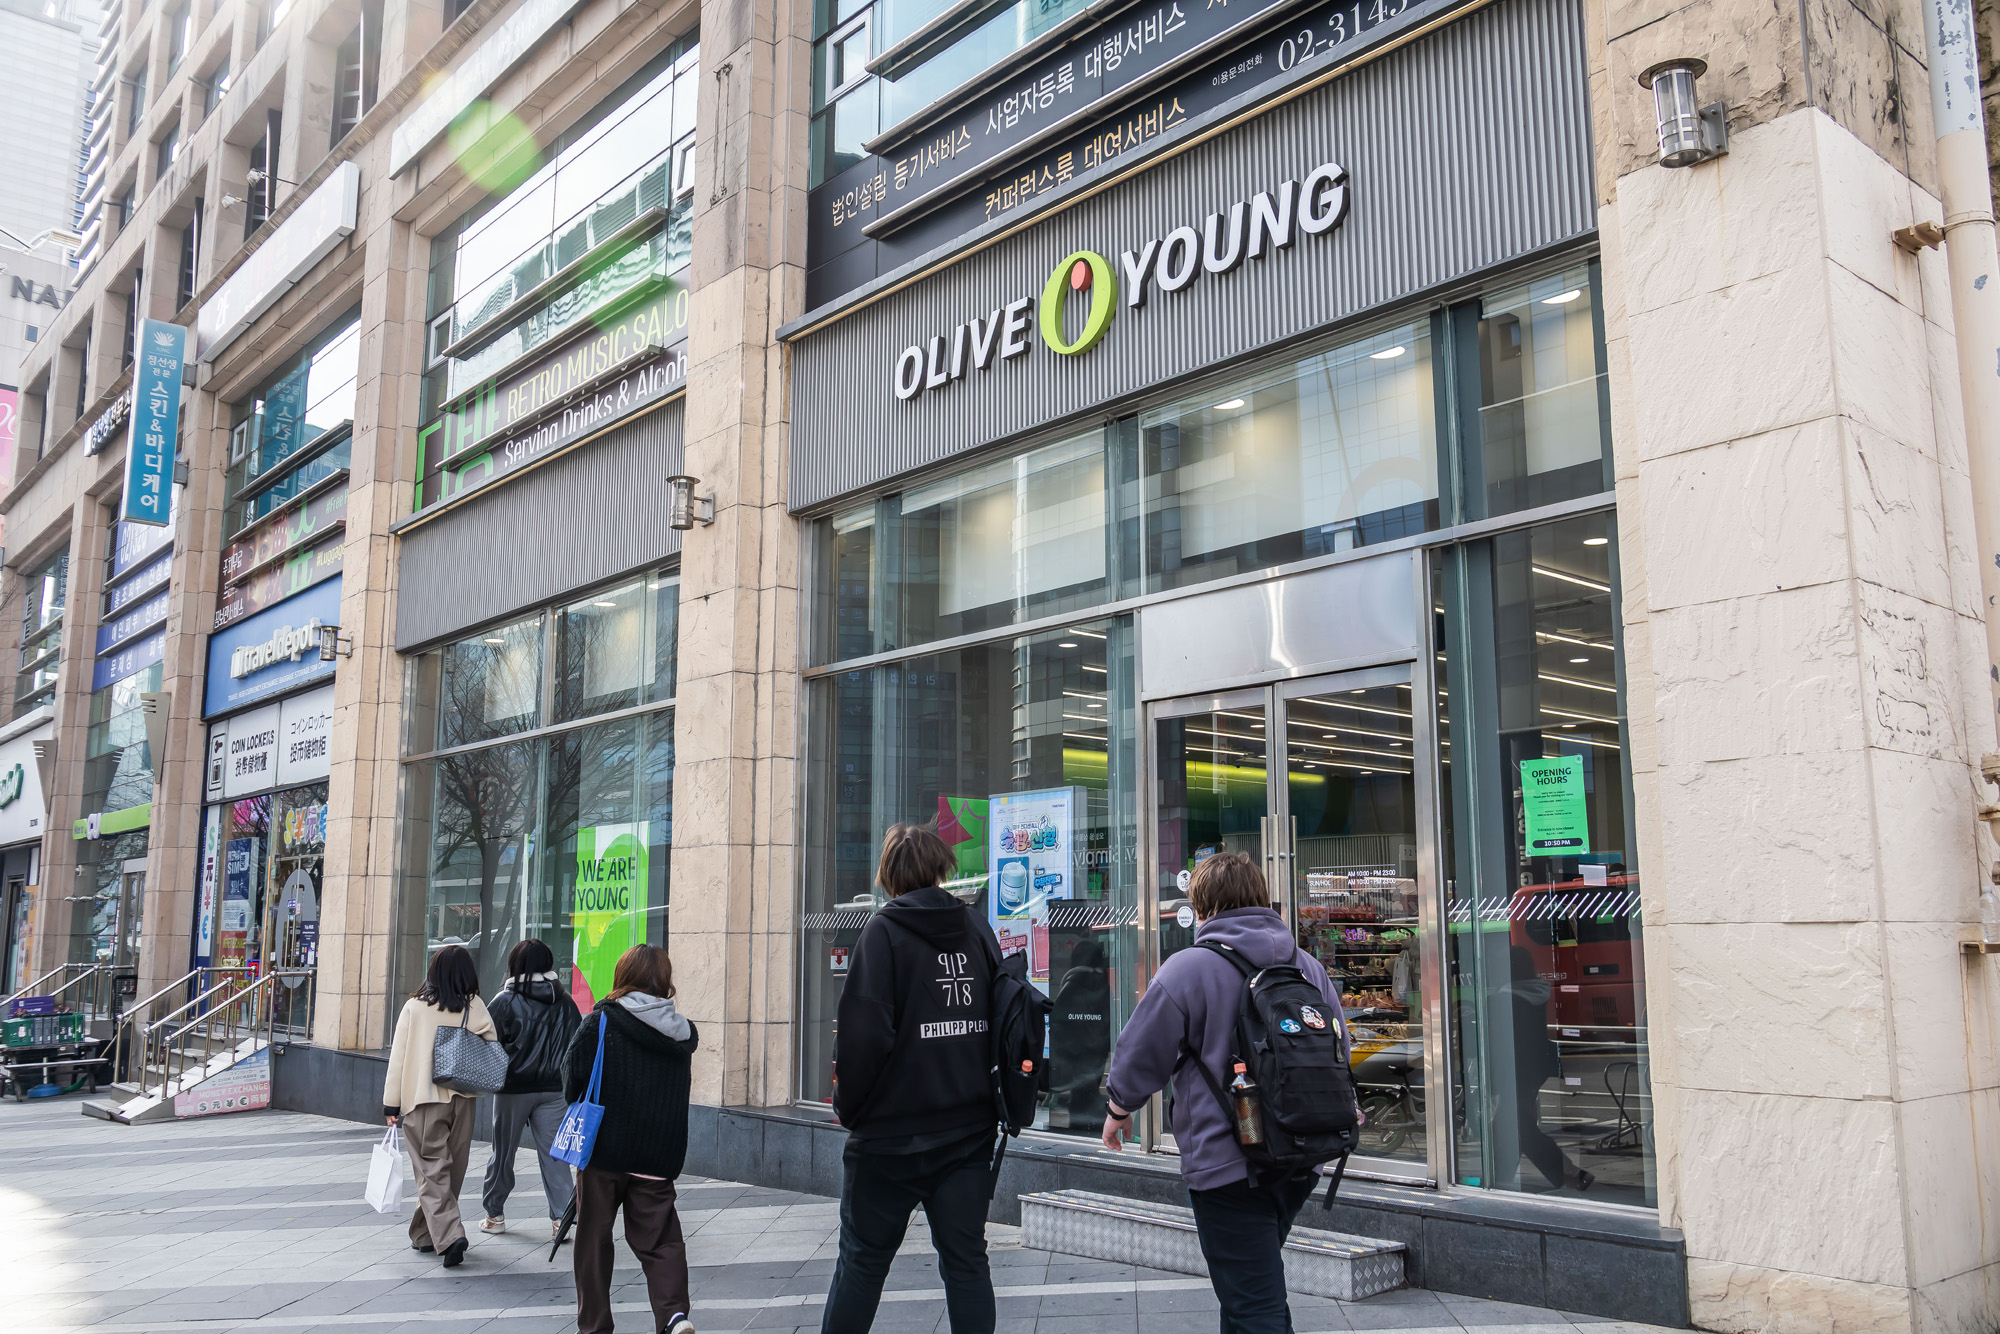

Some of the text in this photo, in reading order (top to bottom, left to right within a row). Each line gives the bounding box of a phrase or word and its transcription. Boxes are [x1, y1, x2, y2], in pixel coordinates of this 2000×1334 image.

[832, 1, 1187, 227] 법인설립 등기서비스 사업자등록 대행서비스
[985, 151, 1075, 222] 컨퍼런스룸
[1084, 97, 1187, 169] 대여서비스
[1212, 53, 1263, 86] 이용문의전화
[895, 296, 1035, 400] OLIVE
[1121, 162, 1349, 309] YOUNG
[147, 354, 177, 370] 정선생
[507, 363, 562, 423] RETRO
[566, 324, 627, 390] MUSIC
[562, 394, 613, 438] Drinks
[617, 379, 631, 410] &
[140, 380, 169, 514] 스킨&바디케어
[110, 634, 165, 678] 문제성 피부
[243, 617, 321, 676] traveldepot
[291, 710, 333, 735] コインロッカー
[231, 730, 275, 754] COIN LOCKERS
[1531, 767, 1572, 778] OPENING
[1536, 776, 1568, 786] HOURS
[227, 861, 240, 875] SIM
[582, 857, 636, 882] WE ARE
[577, 886, 629, 911] YOUNG
[923, 1021, 965, 1037] PHILIPP
[199, 1082, 269, 1099] MONEY EXCHANGE
